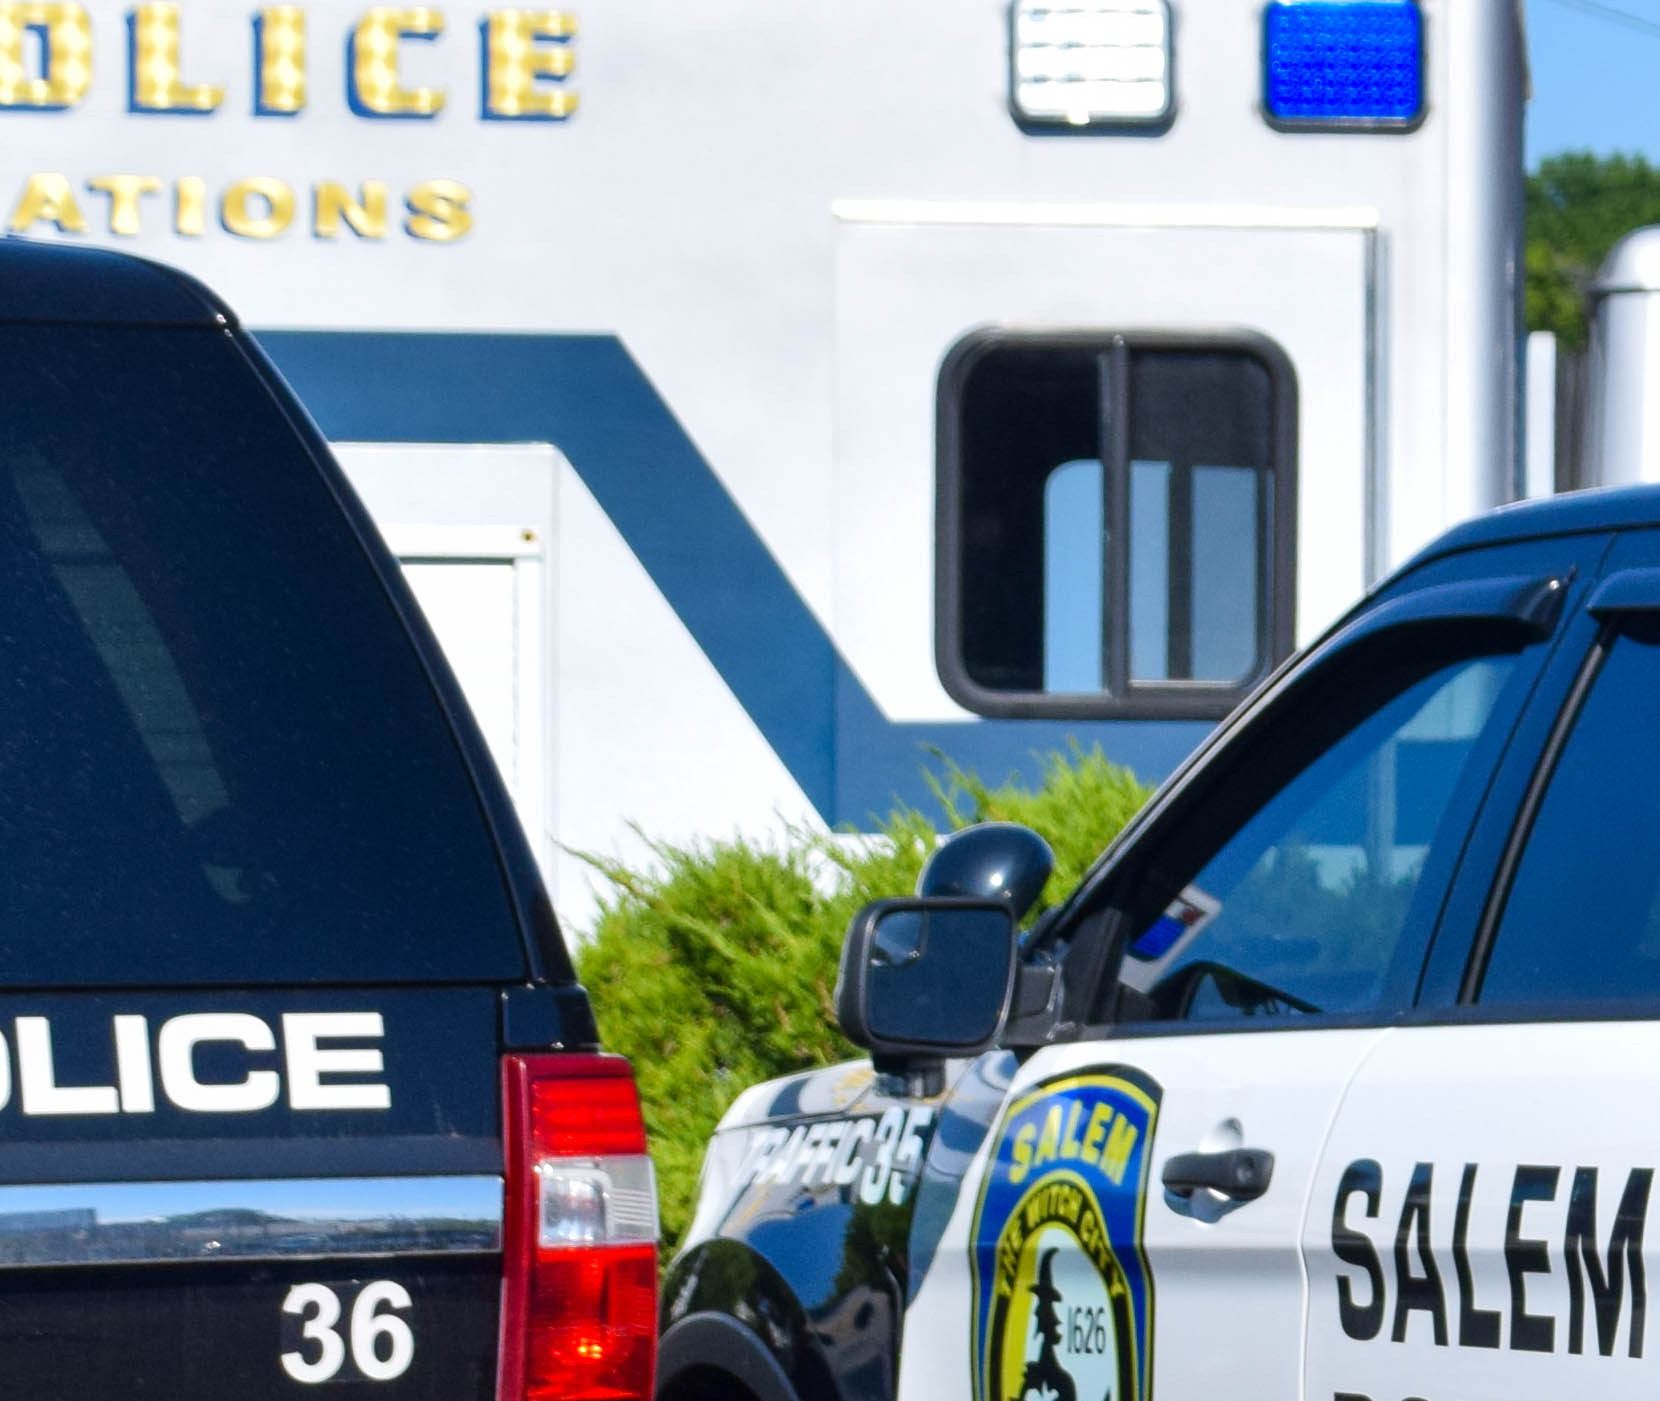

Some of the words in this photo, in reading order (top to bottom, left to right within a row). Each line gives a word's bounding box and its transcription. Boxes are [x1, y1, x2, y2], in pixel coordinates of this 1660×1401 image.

[8, 172, 477, 242] ATIONS
[0, 1011, 392, 1114] LICE
[729, 1120, 876, 1185] TRAFFIC
[860, 1106, 936, 1206] 35
[1008, 1099, 1139, 1187] SALEM
[1331, 1157, 1655, 1360] SALEM
[279, 1280, 415, 1384] 36
[1067, 1306, 1107, 1354] 1626
